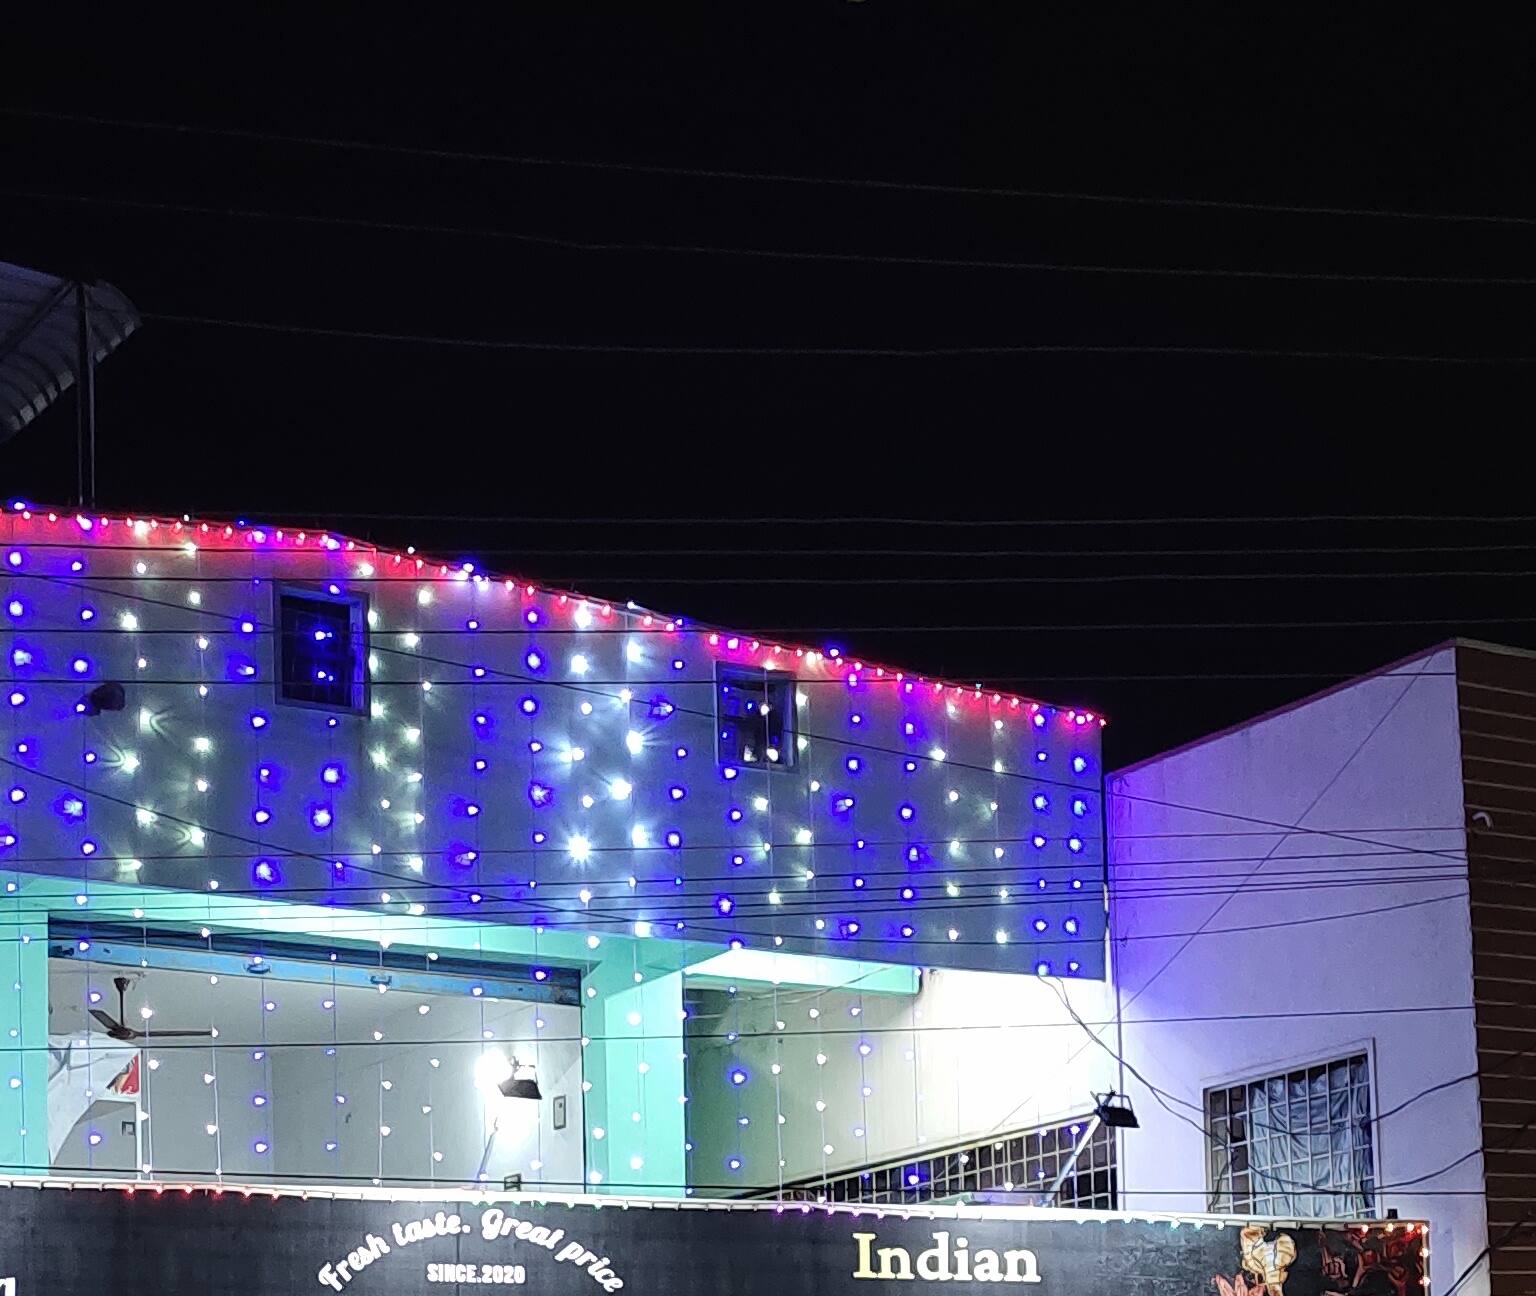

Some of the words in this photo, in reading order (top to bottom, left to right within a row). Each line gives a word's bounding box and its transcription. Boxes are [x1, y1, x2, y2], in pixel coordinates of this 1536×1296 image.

[317, 1233, 391, 1292] Fresh
[391, 1211, 471, 1247] taste.
[480, 1208, 564, 1250] Great
[553, 1241, 624, 1293] price
[426, 1263, 527, 1284] SINCE.2020
[852, 1231, 1041, 1283] Indian
